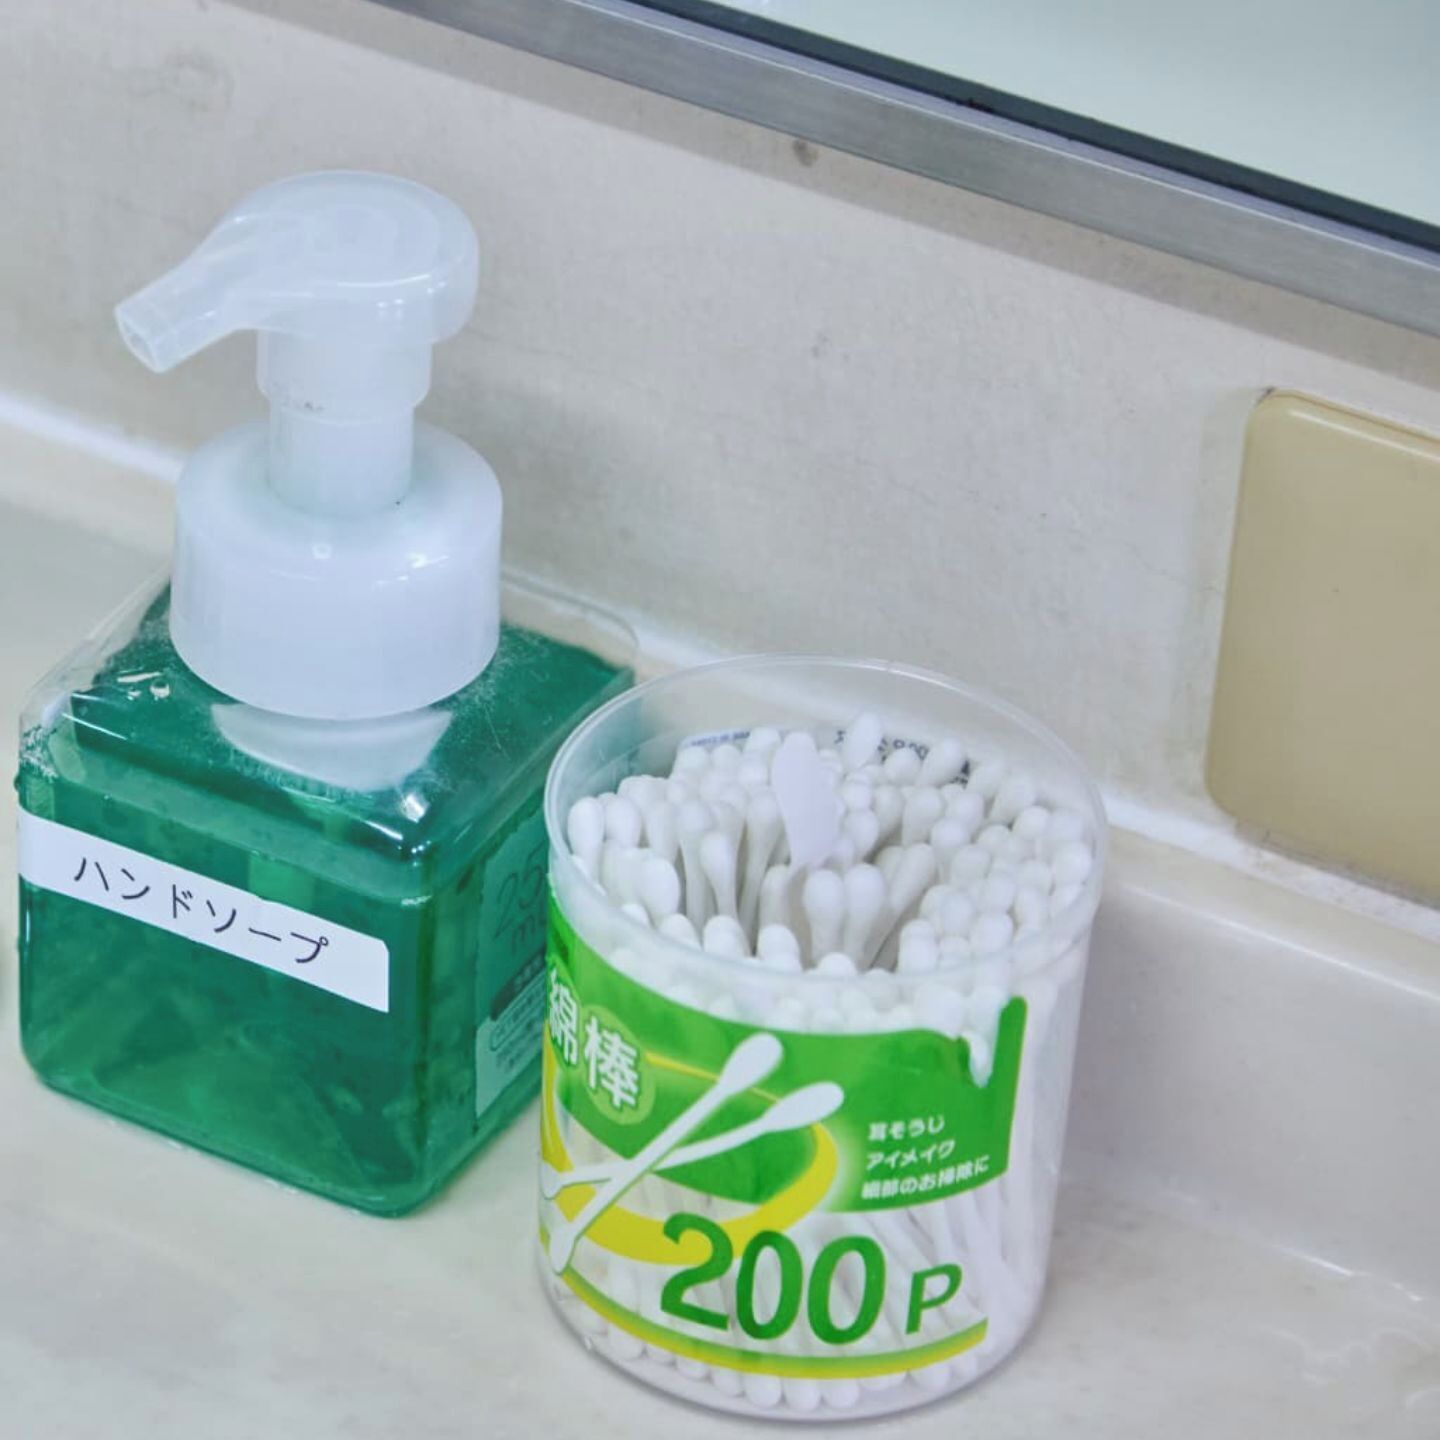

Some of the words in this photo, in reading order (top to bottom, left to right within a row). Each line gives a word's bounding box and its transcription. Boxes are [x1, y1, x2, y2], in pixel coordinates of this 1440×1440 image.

[73, 854, 329, 964] ハンドソープ
[549, 967, 638, 1108] 綿棒
[866, 1139, 956, 1170] アイメイク
[661, 1211, 886, 1345] 200
[906, 1264, 962, 1335] P
